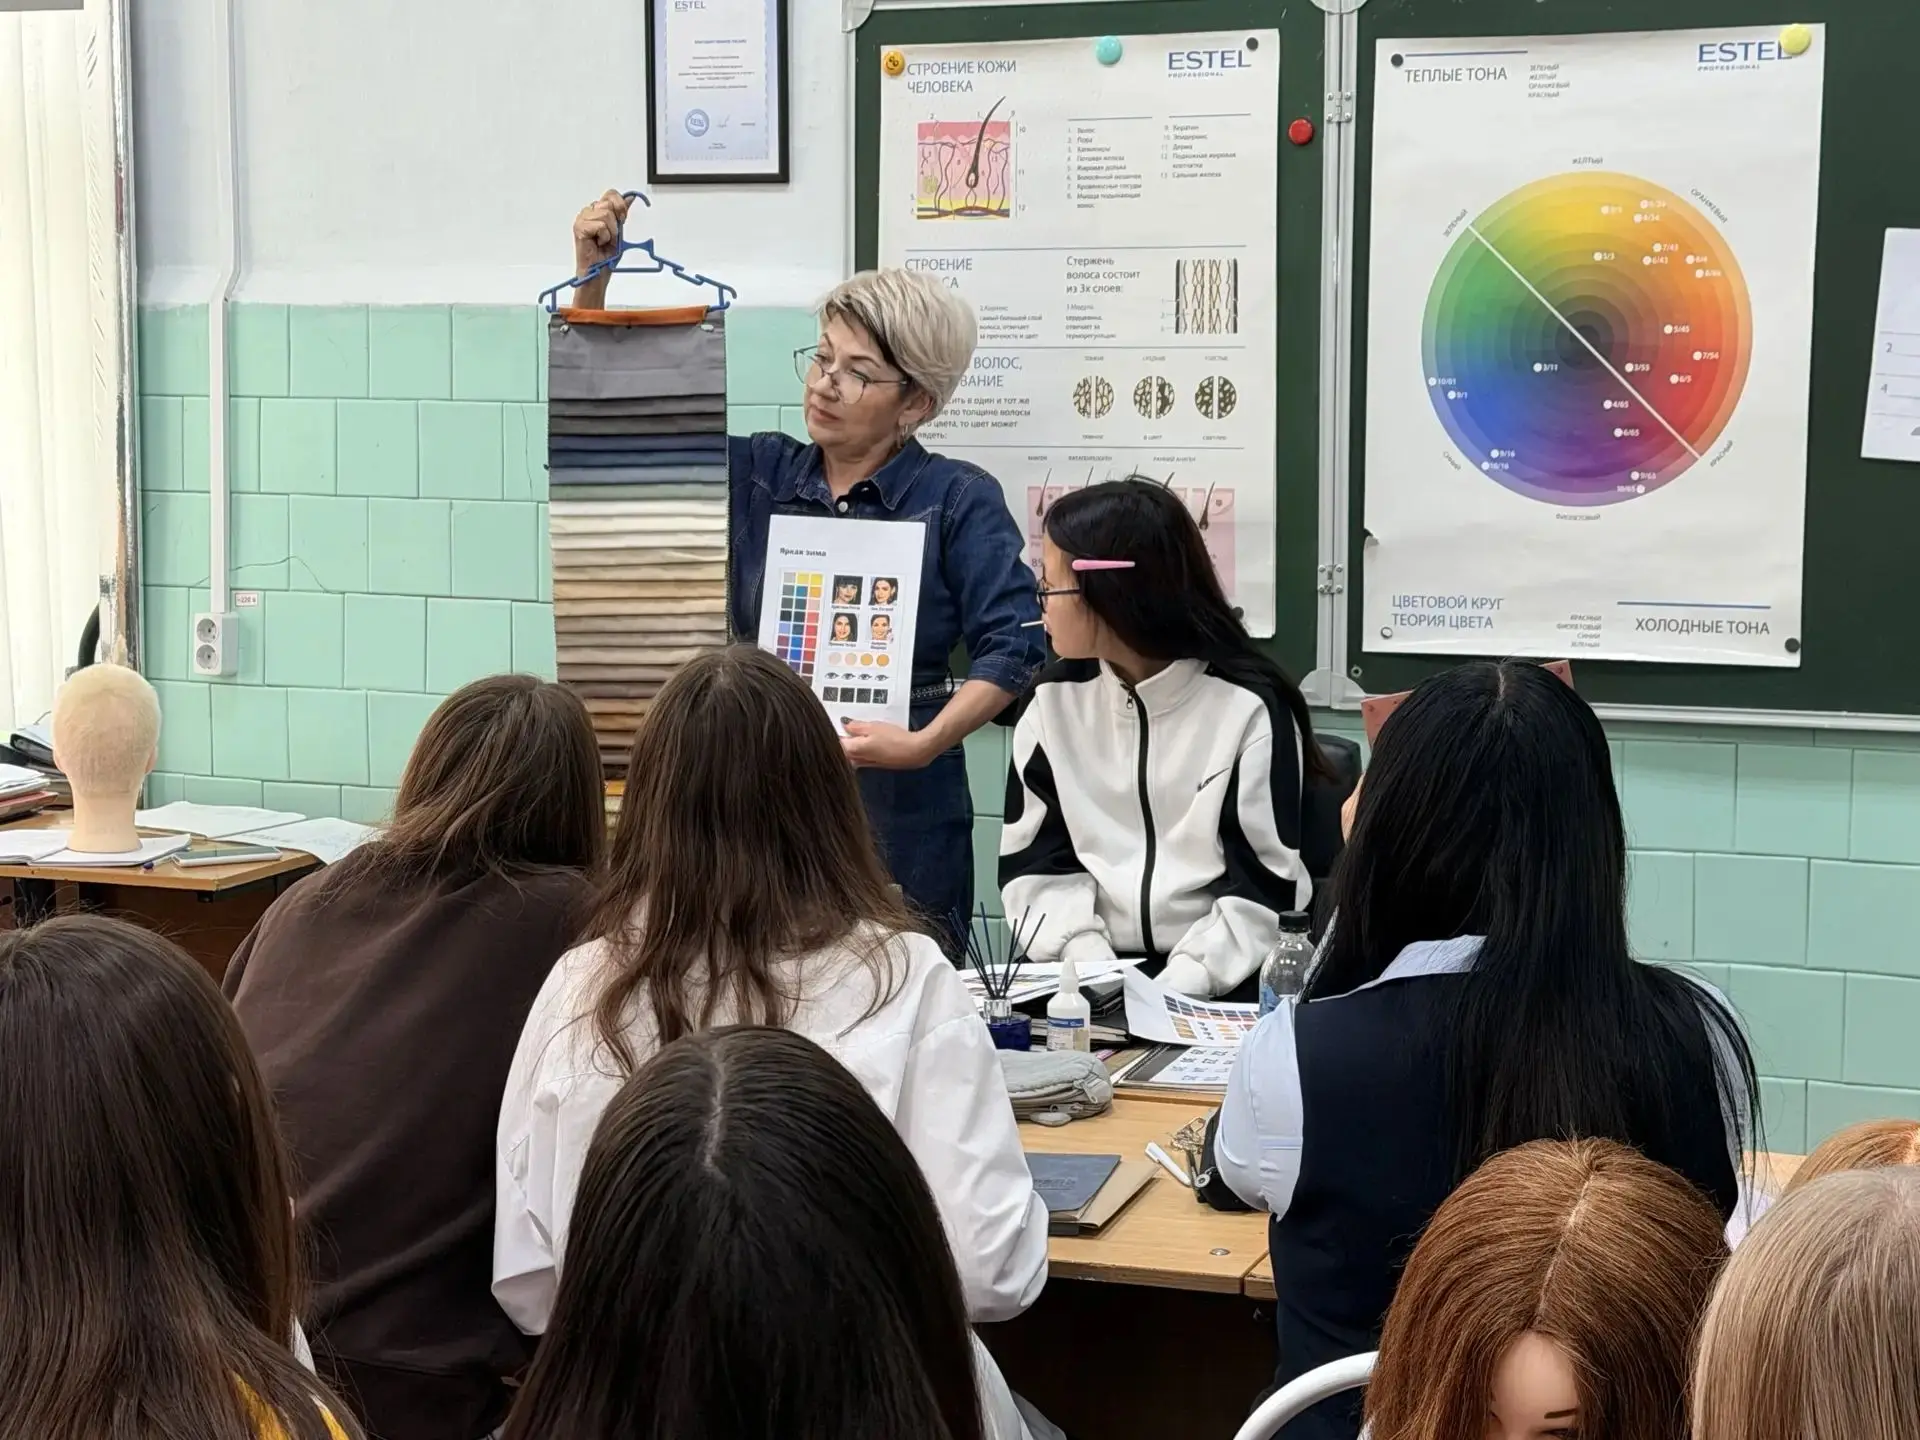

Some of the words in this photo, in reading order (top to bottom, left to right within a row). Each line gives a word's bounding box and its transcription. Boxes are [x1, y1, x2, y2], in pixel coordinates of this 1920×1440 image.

[675, 1, 706, 10] ESTEL
[1698, 41, 1792, 63] ESTEL
[1168, 50, 1252, 70] ESTEL
[907, 62, 974, 76] СТРОЕНИЕ
[977, 60, 1017, 73] КОЖИ
[1405, 68, 1462, 83] ТЕПЛЫЕ
[1466, 67, 1508, 81] ТОНА
[907, 80, 973, 94] ЧЕЛОВЕКА
[905, 258, 973, 271] СТРОЕНИЕ
[1067, 256, 1115, 267] Стержень
[1102, 271, 1141, 279] состоит
[1067, 285, 1078, 293] из
[1885, 342, 1893, 354] 2
[974, 357, 1023, 370] ВОЛОС,
[780, 548, 804, 556] Яркая
[806, 549, 827, 557] зима
[1393, 595, 1468, 610] ЦВЕТОВОЙ
[1472, 597, 1505, 610] КРУГ
[1392, 613, 1446, 627] ТЕОРИЯ
[1450, 615, 1493, 630] ЦВЕТА
[1636, 618, 1723, 635] ХОЛОДНЫЕ
[1727, 621, 1770, 635] ТОНА
